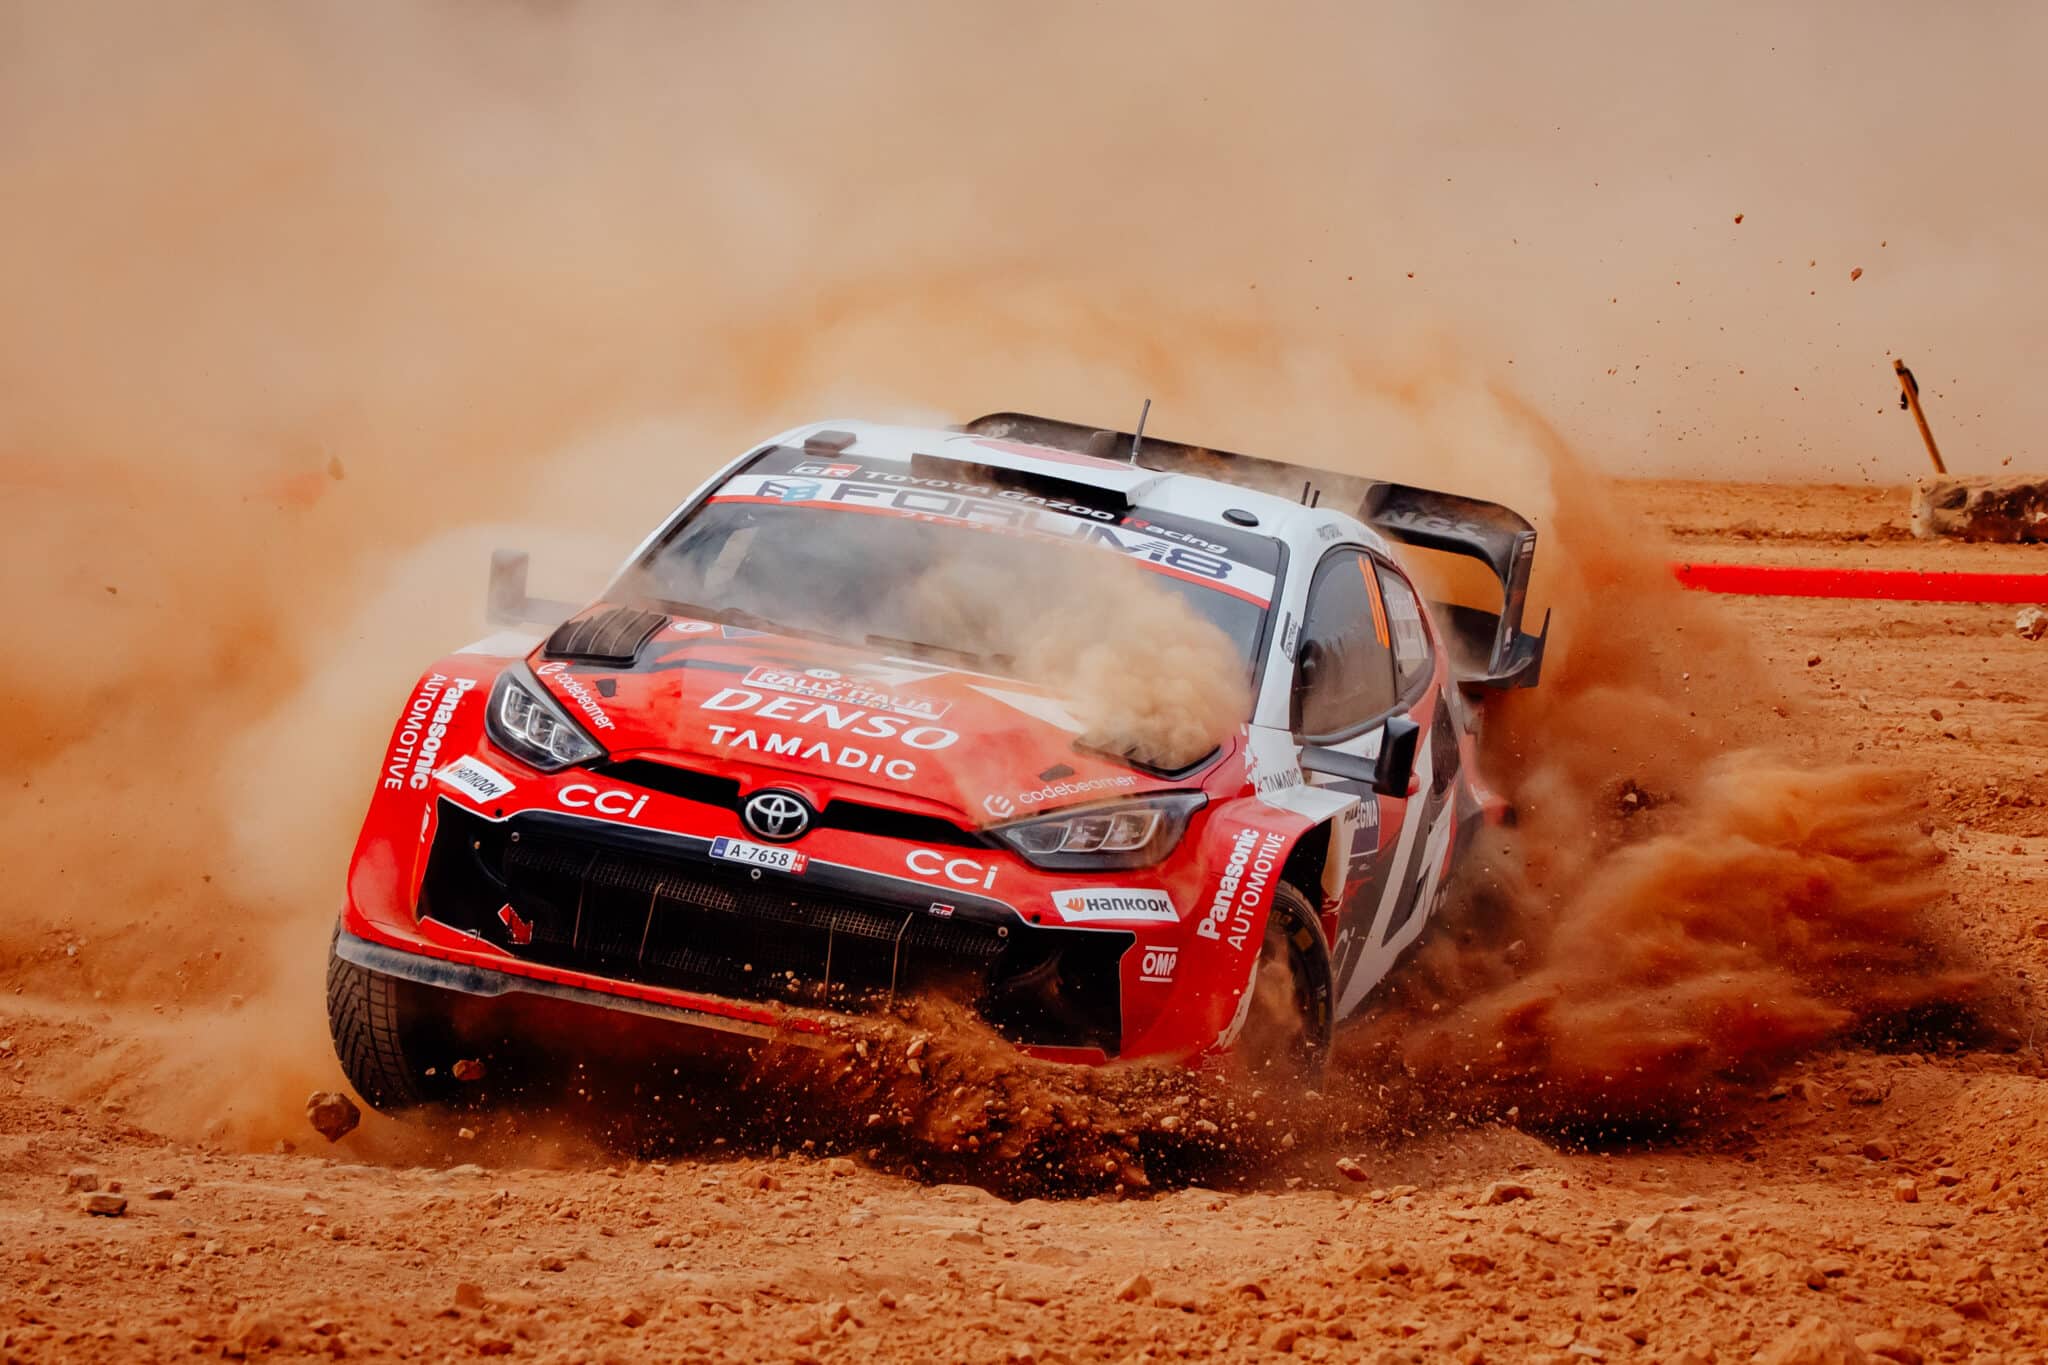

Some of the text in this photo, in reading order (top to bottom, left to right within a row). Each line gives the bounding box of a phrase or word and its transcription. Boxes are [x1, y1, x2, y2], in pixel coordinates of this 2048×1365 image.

[831, 482, 1233, 580] FORUM8
[864, 470, 991, 495] TOYOTA
[998, 489, 1116, 522] GAZOO
[1120, 516, 1229, 555] Racing
[554, 672, 616, 731] codebeamer
[701, 688, 960, 751] DENSO
[759, 671, 843, 694] RALLY
[847, 688, 933, 713] ITALIA
[384, 672, 448, 790] AUTOMOTIVE
[410, 677, 478, 790] Panasonic
[708, 724, 917, 781] TAMADIC
[1019, 775, 1136, 805] codebeamer
[730, 845, 789, 866] A-7658
[1196, 828, 1260, 940] Panasonic
[1227, 832, 1286, 952] AUTOMOTIVE
[1142, 951, 1178, 977] OMP
